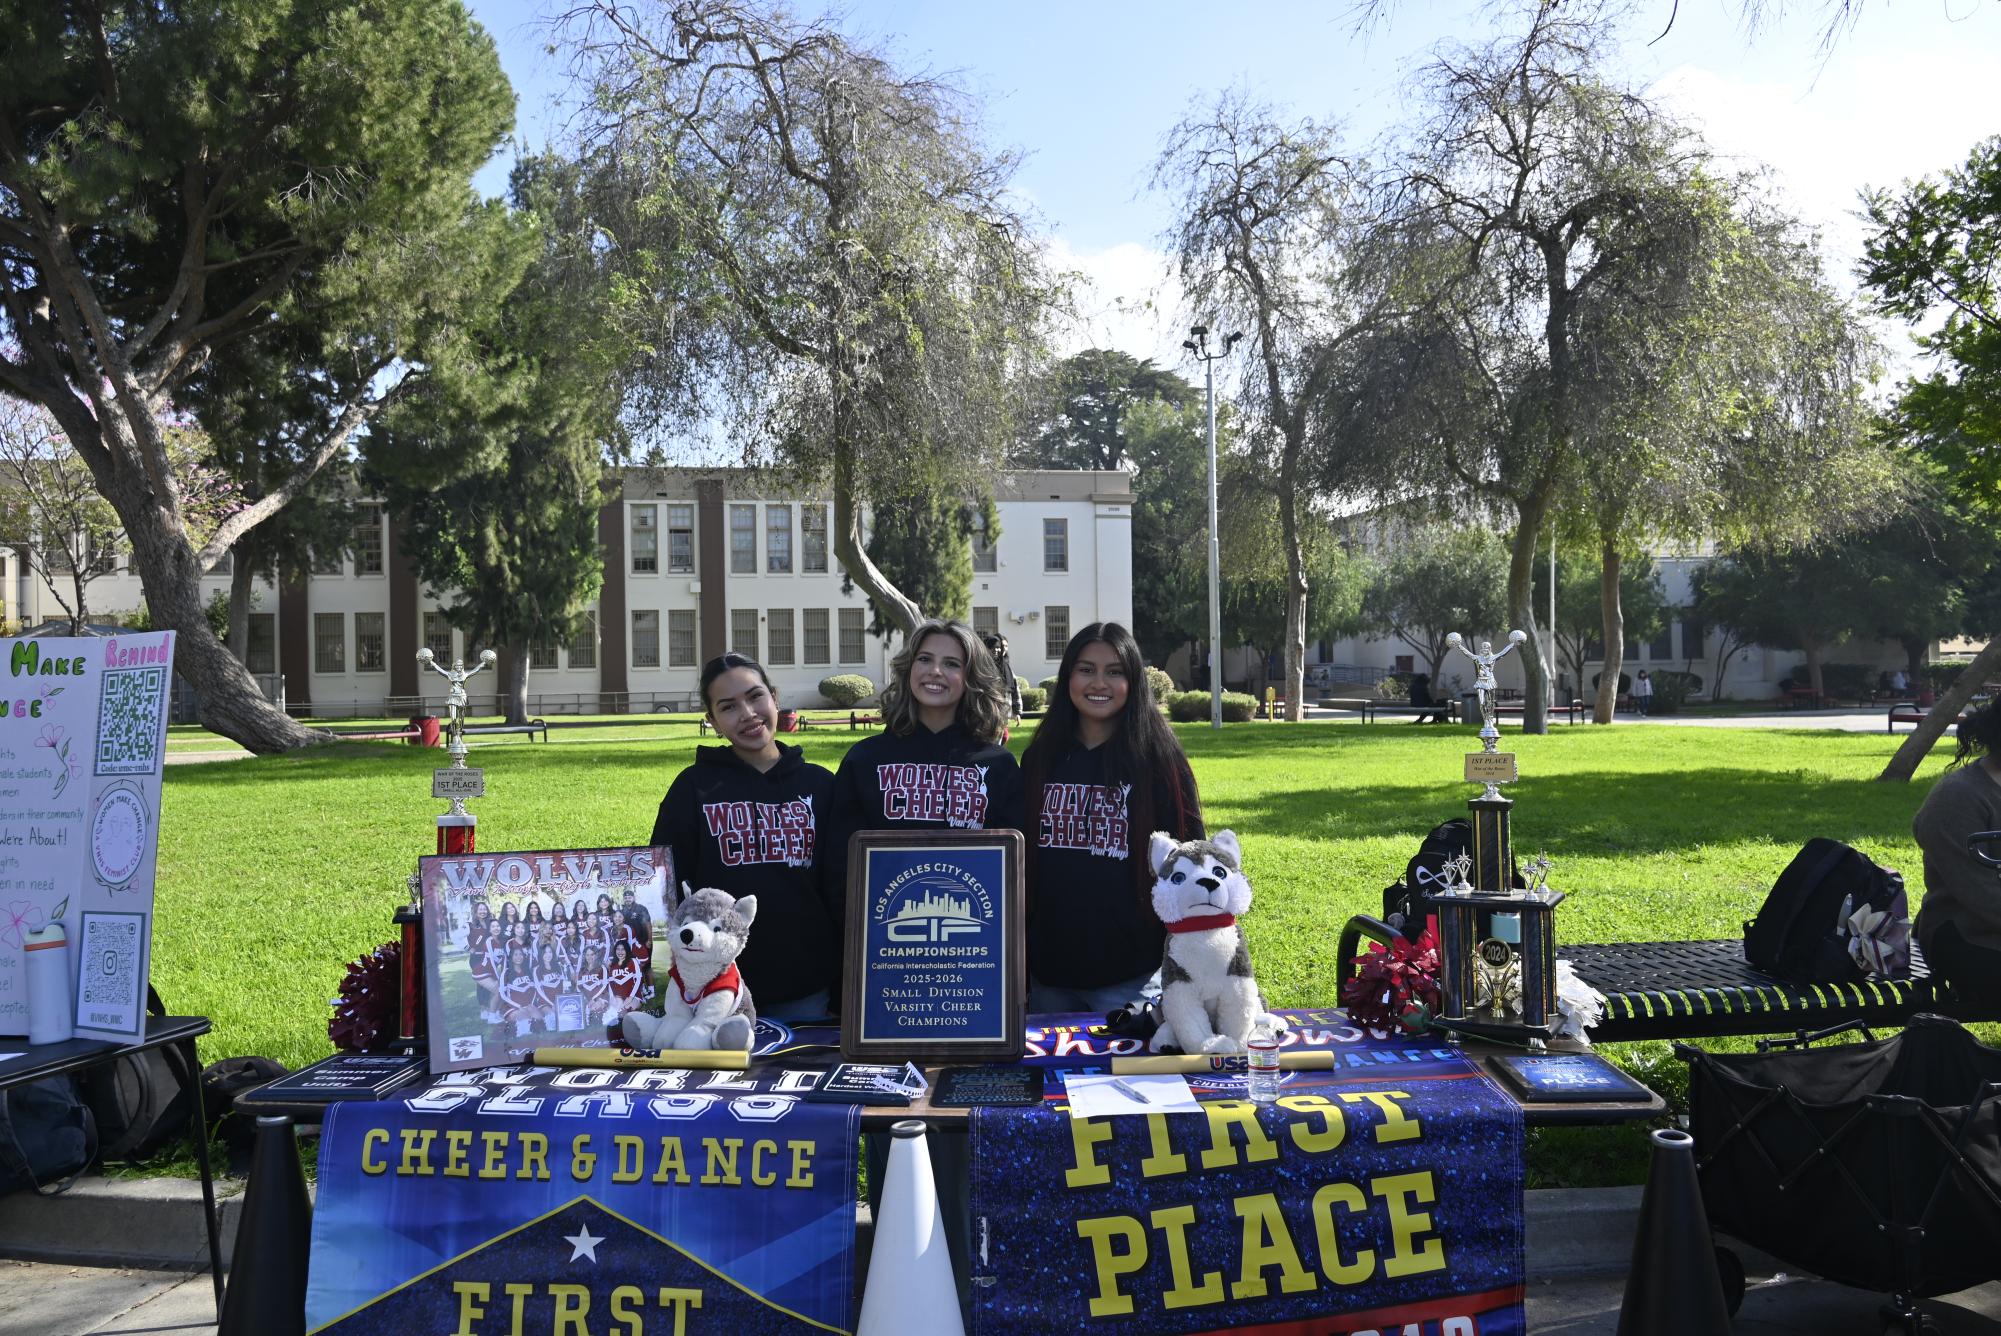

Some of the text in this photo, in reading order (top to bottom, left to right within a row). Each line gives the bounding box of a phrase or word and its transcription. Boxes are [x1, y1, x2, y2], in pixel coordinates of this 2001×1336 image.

[877, 763, 979, 793] WOLVES
[703, 801, 811, 836] WOLVES
[884, 787, 988, 823] CHEER
[29, 827, 67, 846] About!
[718, 828, 815, 866] CHEER
[1039, 813, 1129, 849] CHEER
[440, 852, 655, 891] WOLVES
[874, 862, 994, 920] LOS ANGELES CITY SECTION
[887, 918, 981, 942] CIF
[872, 962, 904, 970] California
[905, 962, 956, 970] Interscholastic
[879, 946, 988, 957] CHAMPIONSHIPS
[1485, 945, 1506, 961] 2024
[882, 988, 984, 998] SMALL DIVISION
[903, 974, 963, 983] 2025-2026
[885, 1001, 981, 1012] VARSITY CHEER
[898, 1016, 968, 1026] CHAMPIONS
[1054, 1091, 1421, 1188] FIRST
[361, 1128, 816, 1188] CHEER & DANCE
[1076, 1171, 1447, 1317] PLACE
[450, 1281, 703, 1336] FIRST
